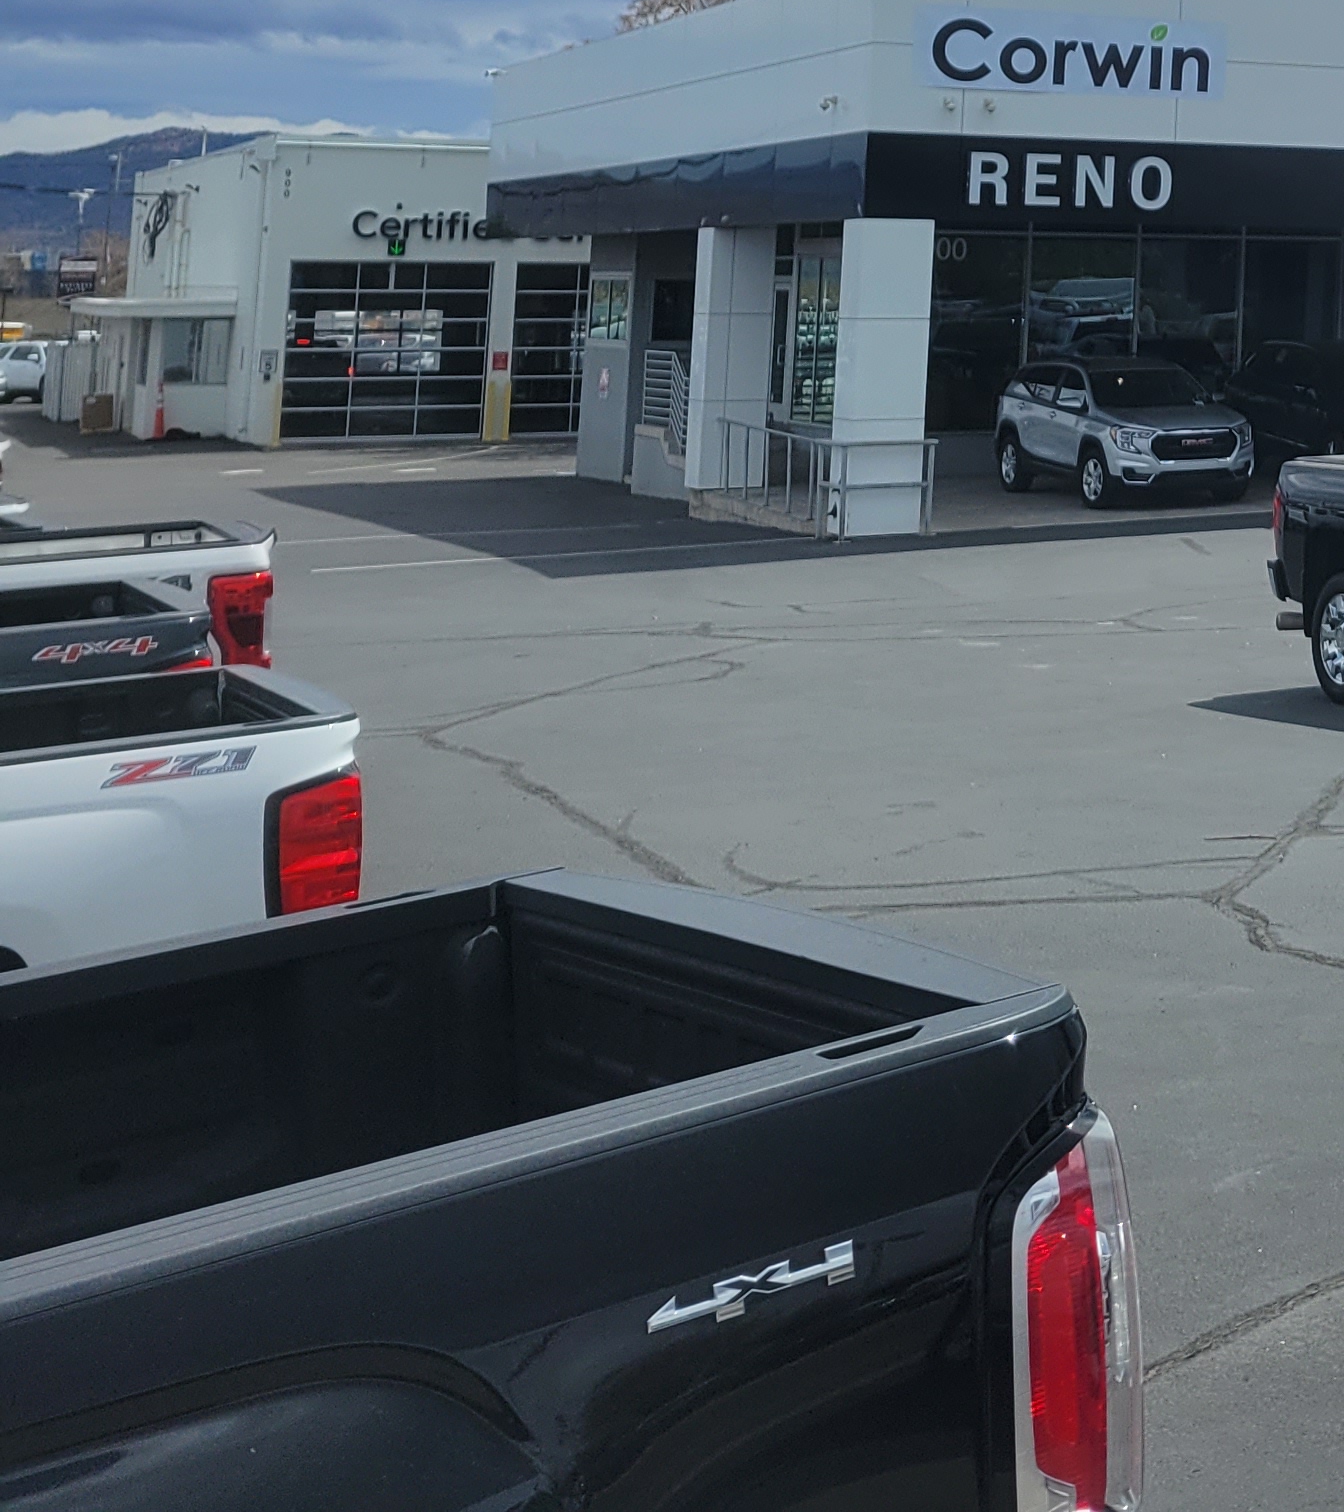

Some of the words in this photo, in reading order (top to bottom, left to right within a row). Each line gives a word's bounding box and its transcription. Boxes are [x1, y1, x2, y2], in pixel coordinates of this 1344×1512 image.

[932, 18, 1210, 93] Corwin
[967, 151, 1173, 210] RENO
[352, 210, 489, 241] Certifie
[100, 745, 257, 789] Z71
